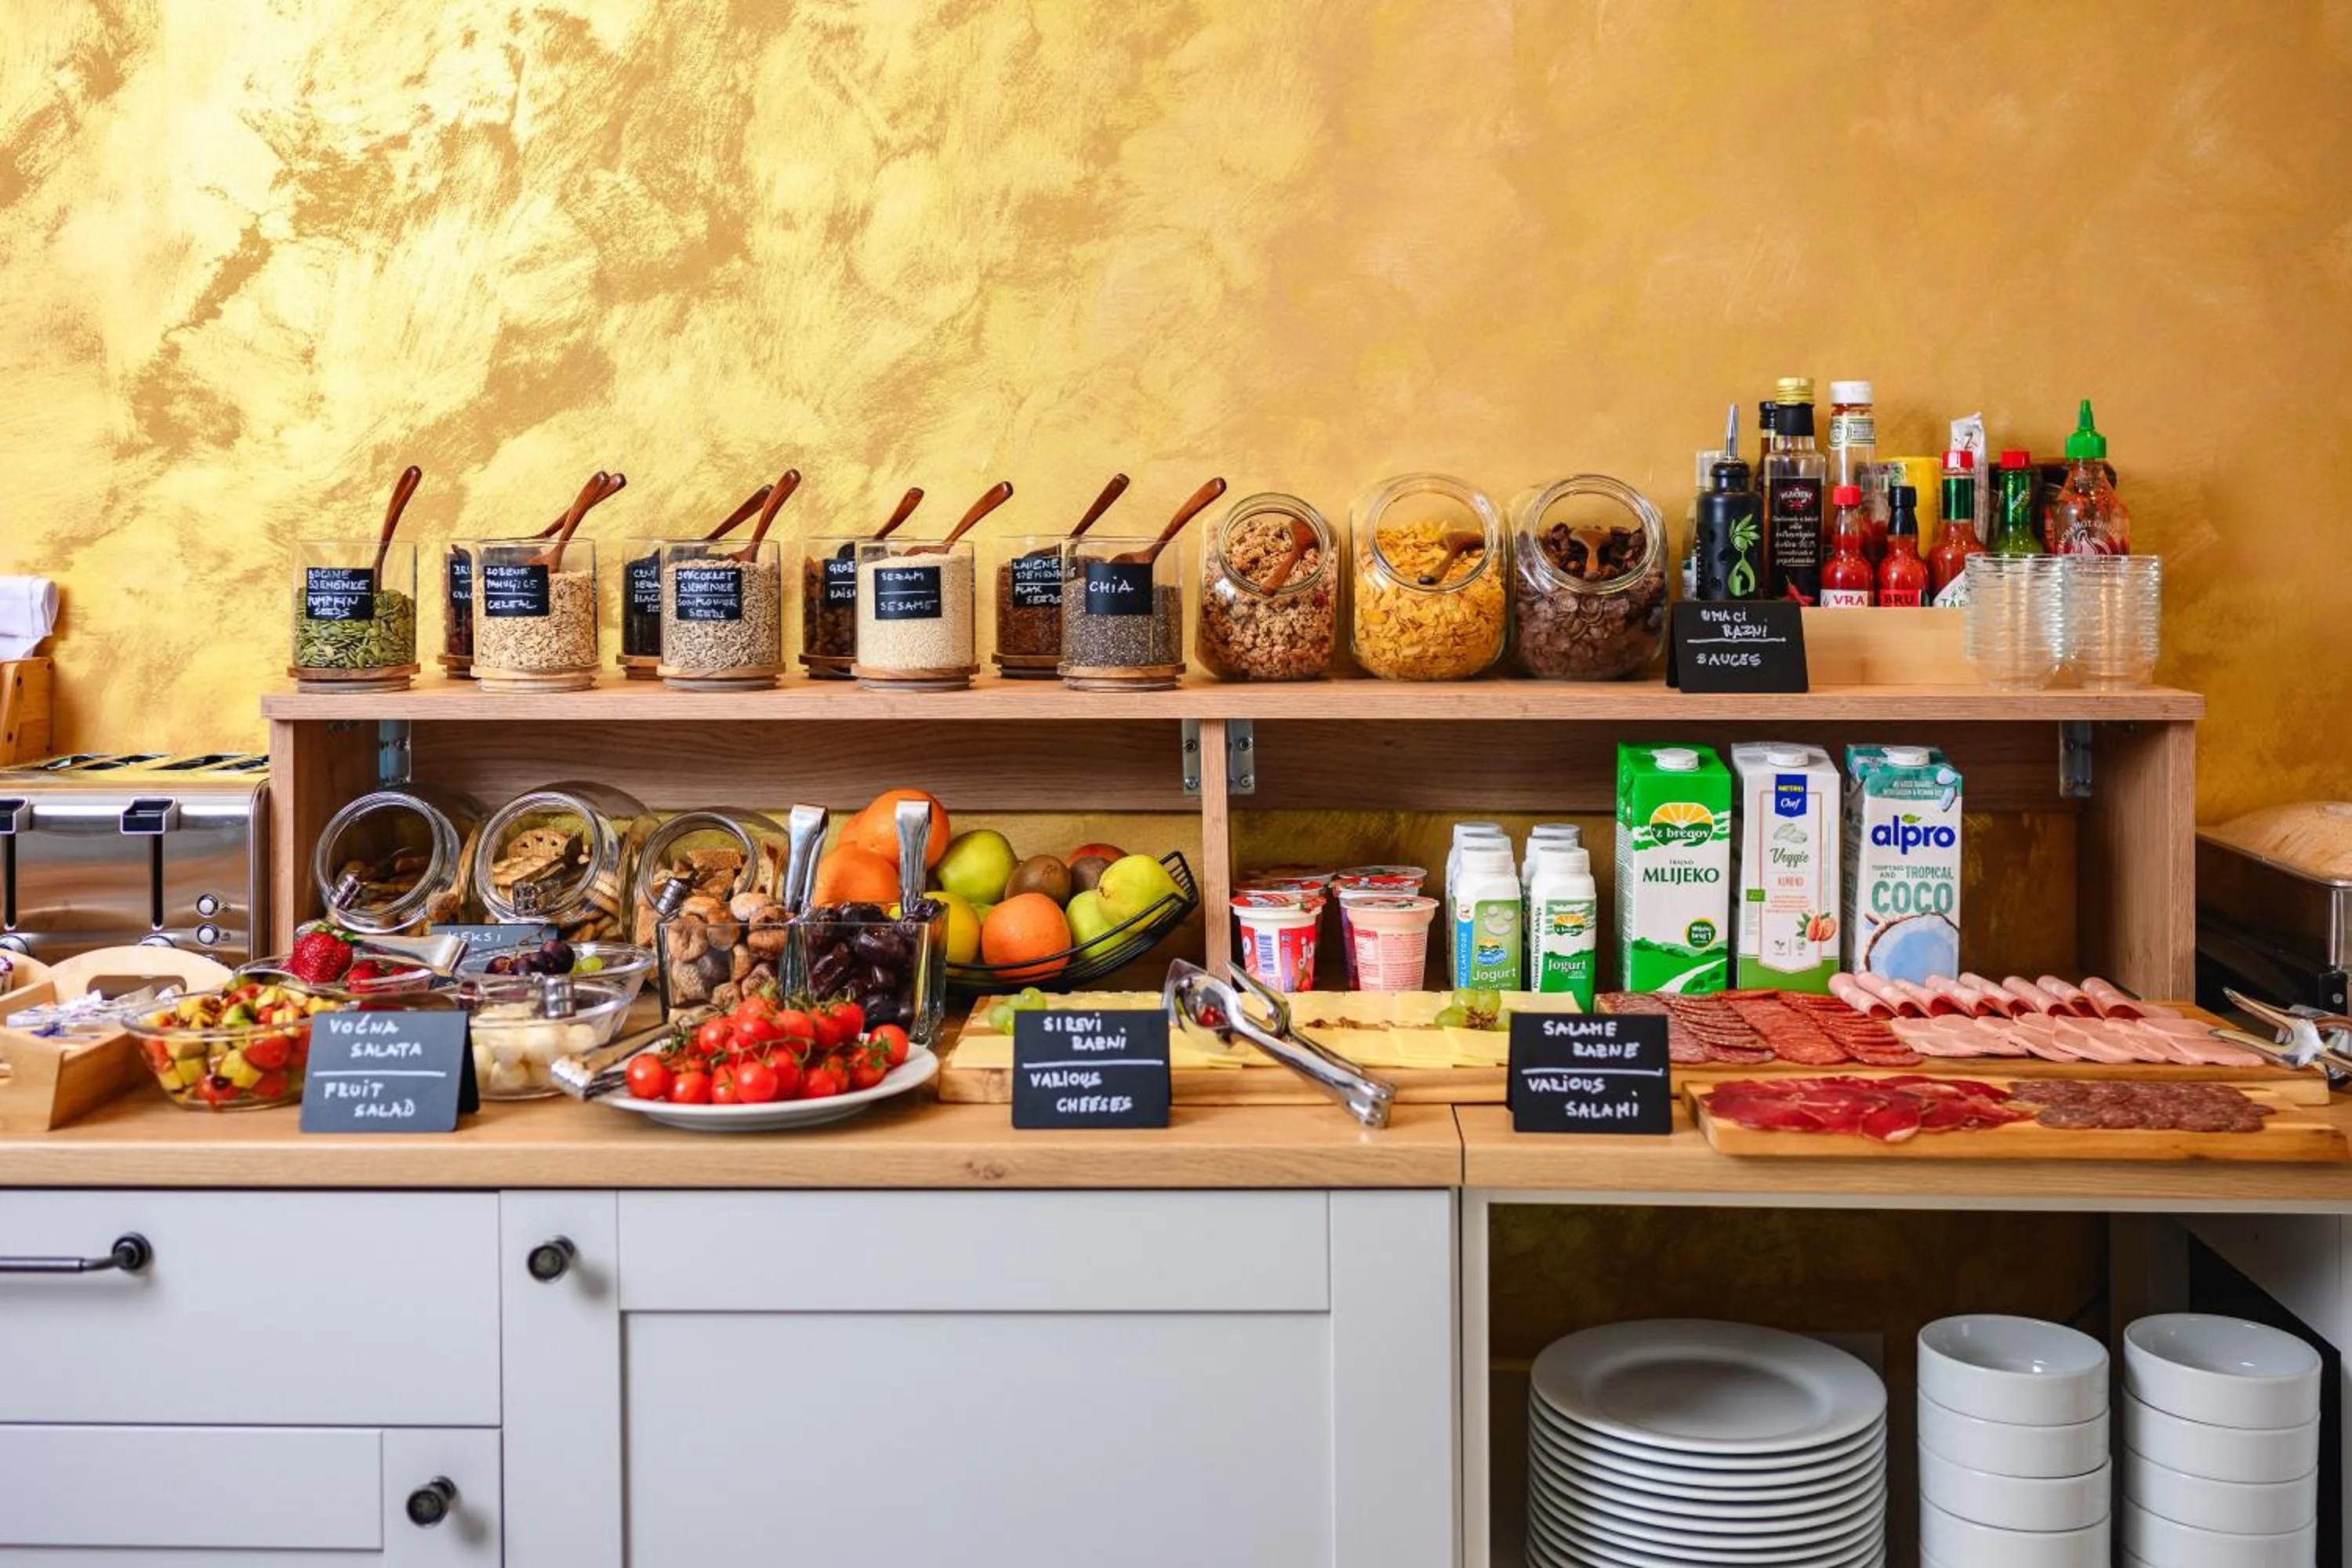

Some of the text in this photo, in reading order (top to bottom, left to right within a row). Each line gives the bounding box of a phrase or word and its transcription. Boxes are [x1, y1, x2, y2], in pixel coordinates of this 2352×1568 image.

[1696, 653, 1762, 666] SAUCES
[1871, 815, 1956, 855] alpro
[1769, 848, 1809, 868] Veggie
[1642, 867, 1720, 884] MLIJEKO
[1905, 866, 1955, 879] TROPICAL
[1871, 880, 1954, 914] COCO
[1549, 959, 1586, 972] Jogurt
[1472, 966, 1516, 982] Jogurt
[350, 1042, 423, 1058] SALATA
[354, 1102, 416, 1118] SALAD
[1056, 1096, 1133, 1112] CHEESES
